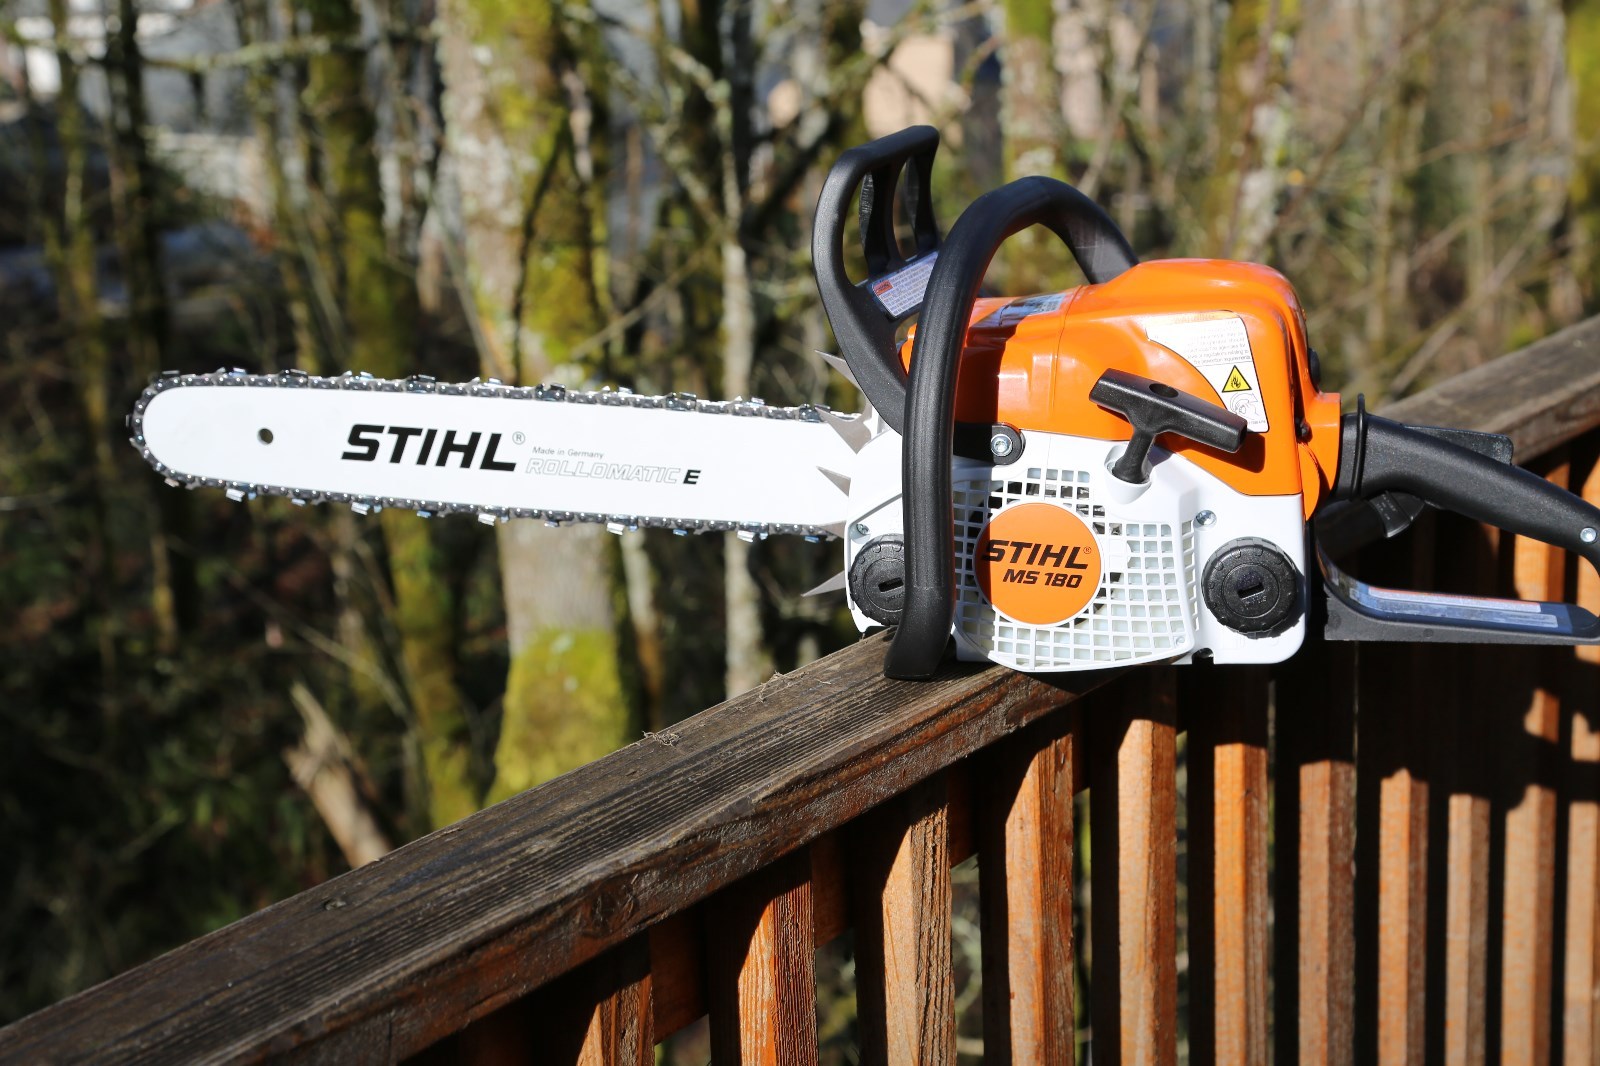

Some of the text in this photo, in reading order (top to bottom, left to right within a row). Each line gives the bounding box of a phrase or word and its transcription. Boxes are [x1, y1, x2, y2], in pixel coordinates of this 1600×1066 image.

[532, 446, 555, 455] Made
[567, 449, 605, 460] Germany
[525, 458, 701, 485] ROLLOMATIC E
[1002, 568, 1083, 589] MS 180
